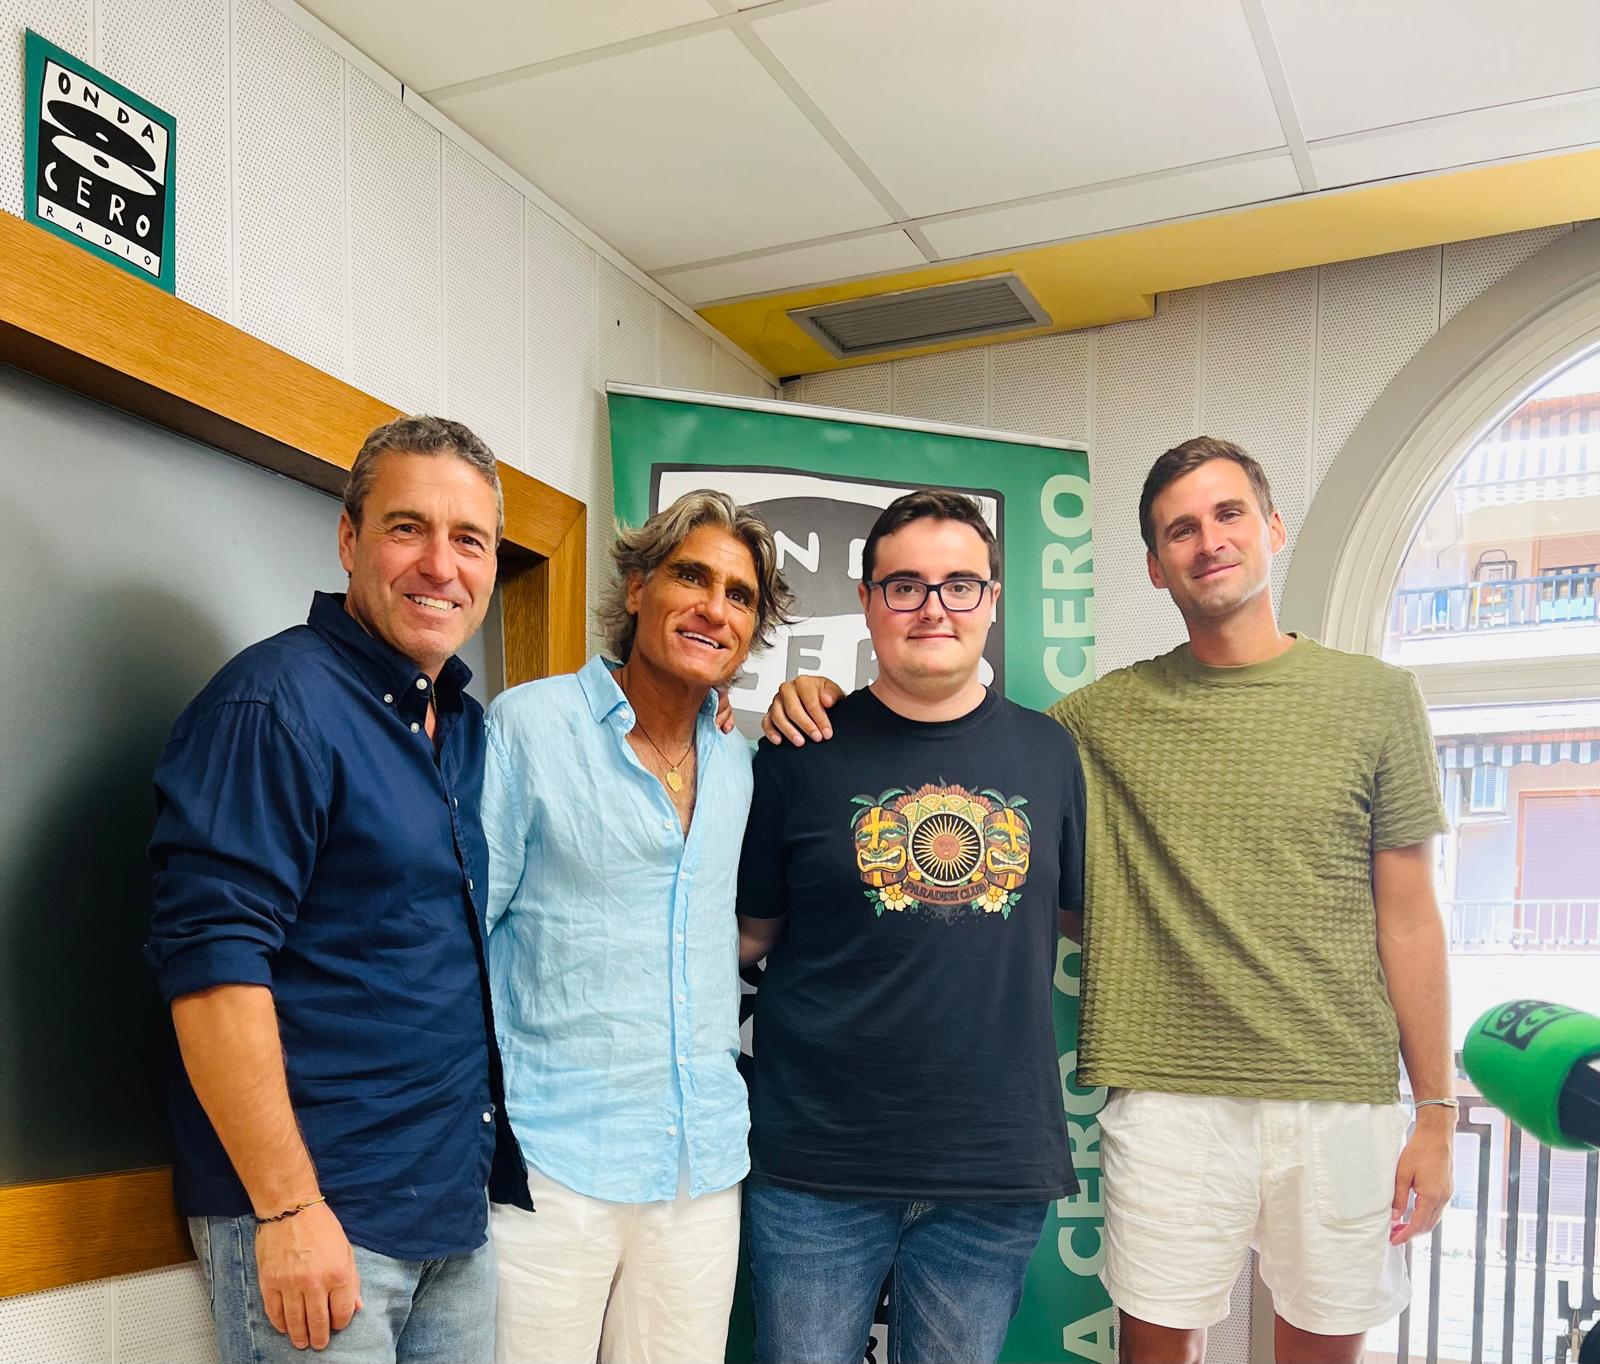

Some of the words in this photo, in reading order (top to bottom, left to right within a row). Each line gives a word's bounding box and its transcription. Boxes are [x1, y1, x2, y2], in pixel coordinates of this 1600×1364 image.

[58, 72, 155, 143] ONDA
[44, 161, 151, 238] CERO
[46, 205, 152, 265] RADIO
[1040, 474, 1097, 694] CERO
[959, 882, 987, 900] CLUB
